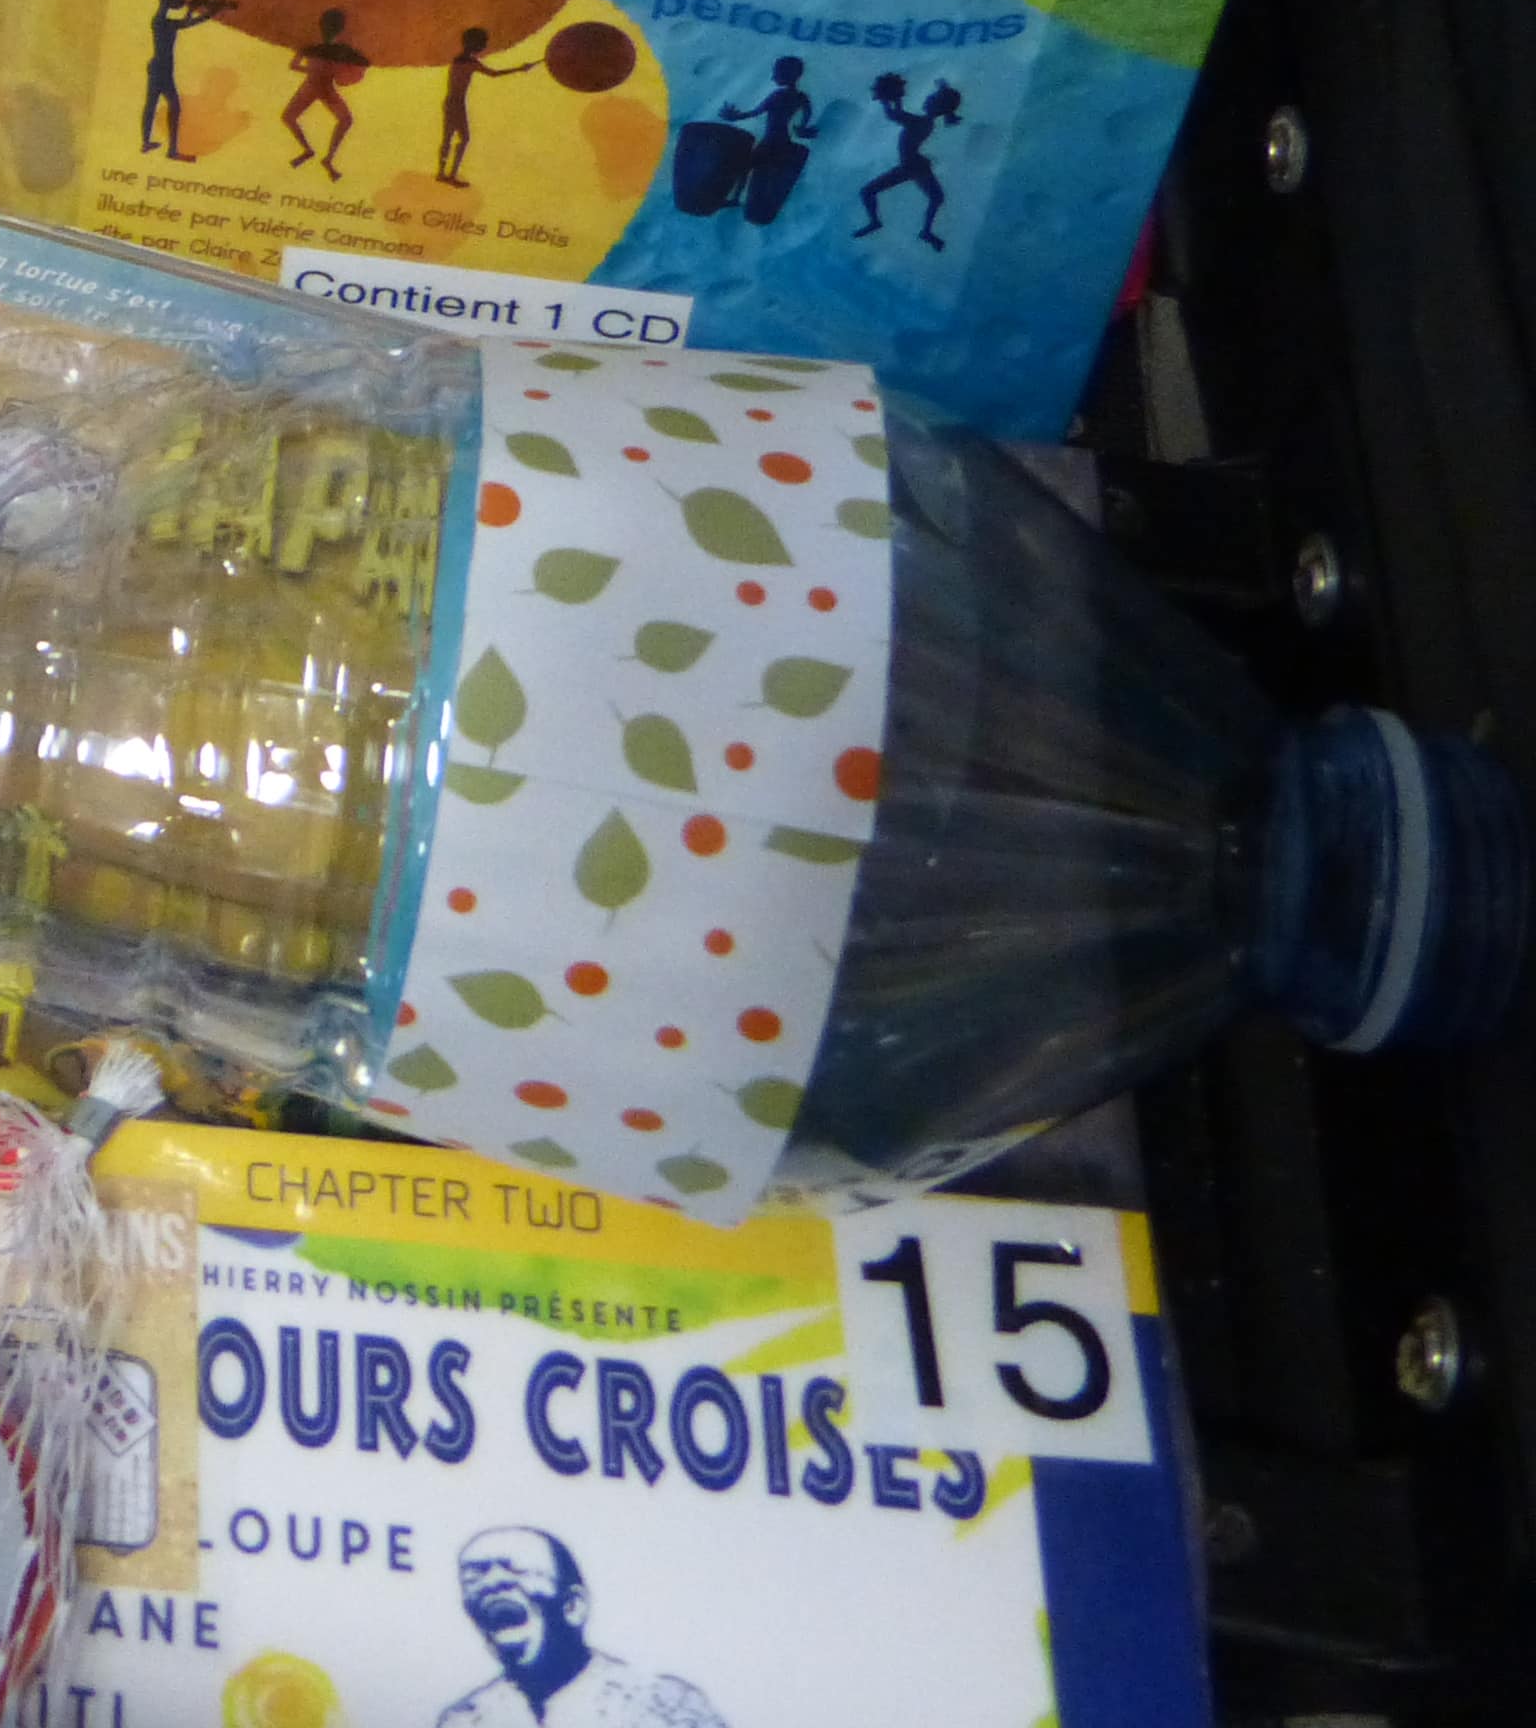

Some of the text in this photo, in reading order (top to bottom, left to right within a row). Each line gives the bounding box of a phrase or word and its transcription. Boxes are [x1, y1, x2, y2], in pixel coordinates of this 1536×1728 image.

[96, 193, 423, 257] illustrée par Valérie Carmona
[101, 168, 570, 249] une promenade musicale de Gilles Dalbis
[13, 259, 99, 298] tortue
[140, 231, 181, 254] par
[188, 238, 252, 265] Claire
[294, 270, 680, 348] Contient 1 CD
[246, 1161, 604, 1235] CHAPTER TWO
[203, 1263, 683, 1334] HIERRY NOSSIN PRÉSENTE
[861, 1235, 1112, 1421] 15
[198, 1316, 476, 1465] OURS
[199, 1508, 416, 1573] OUPE
[88, 1590, 221, 1651] ANE
